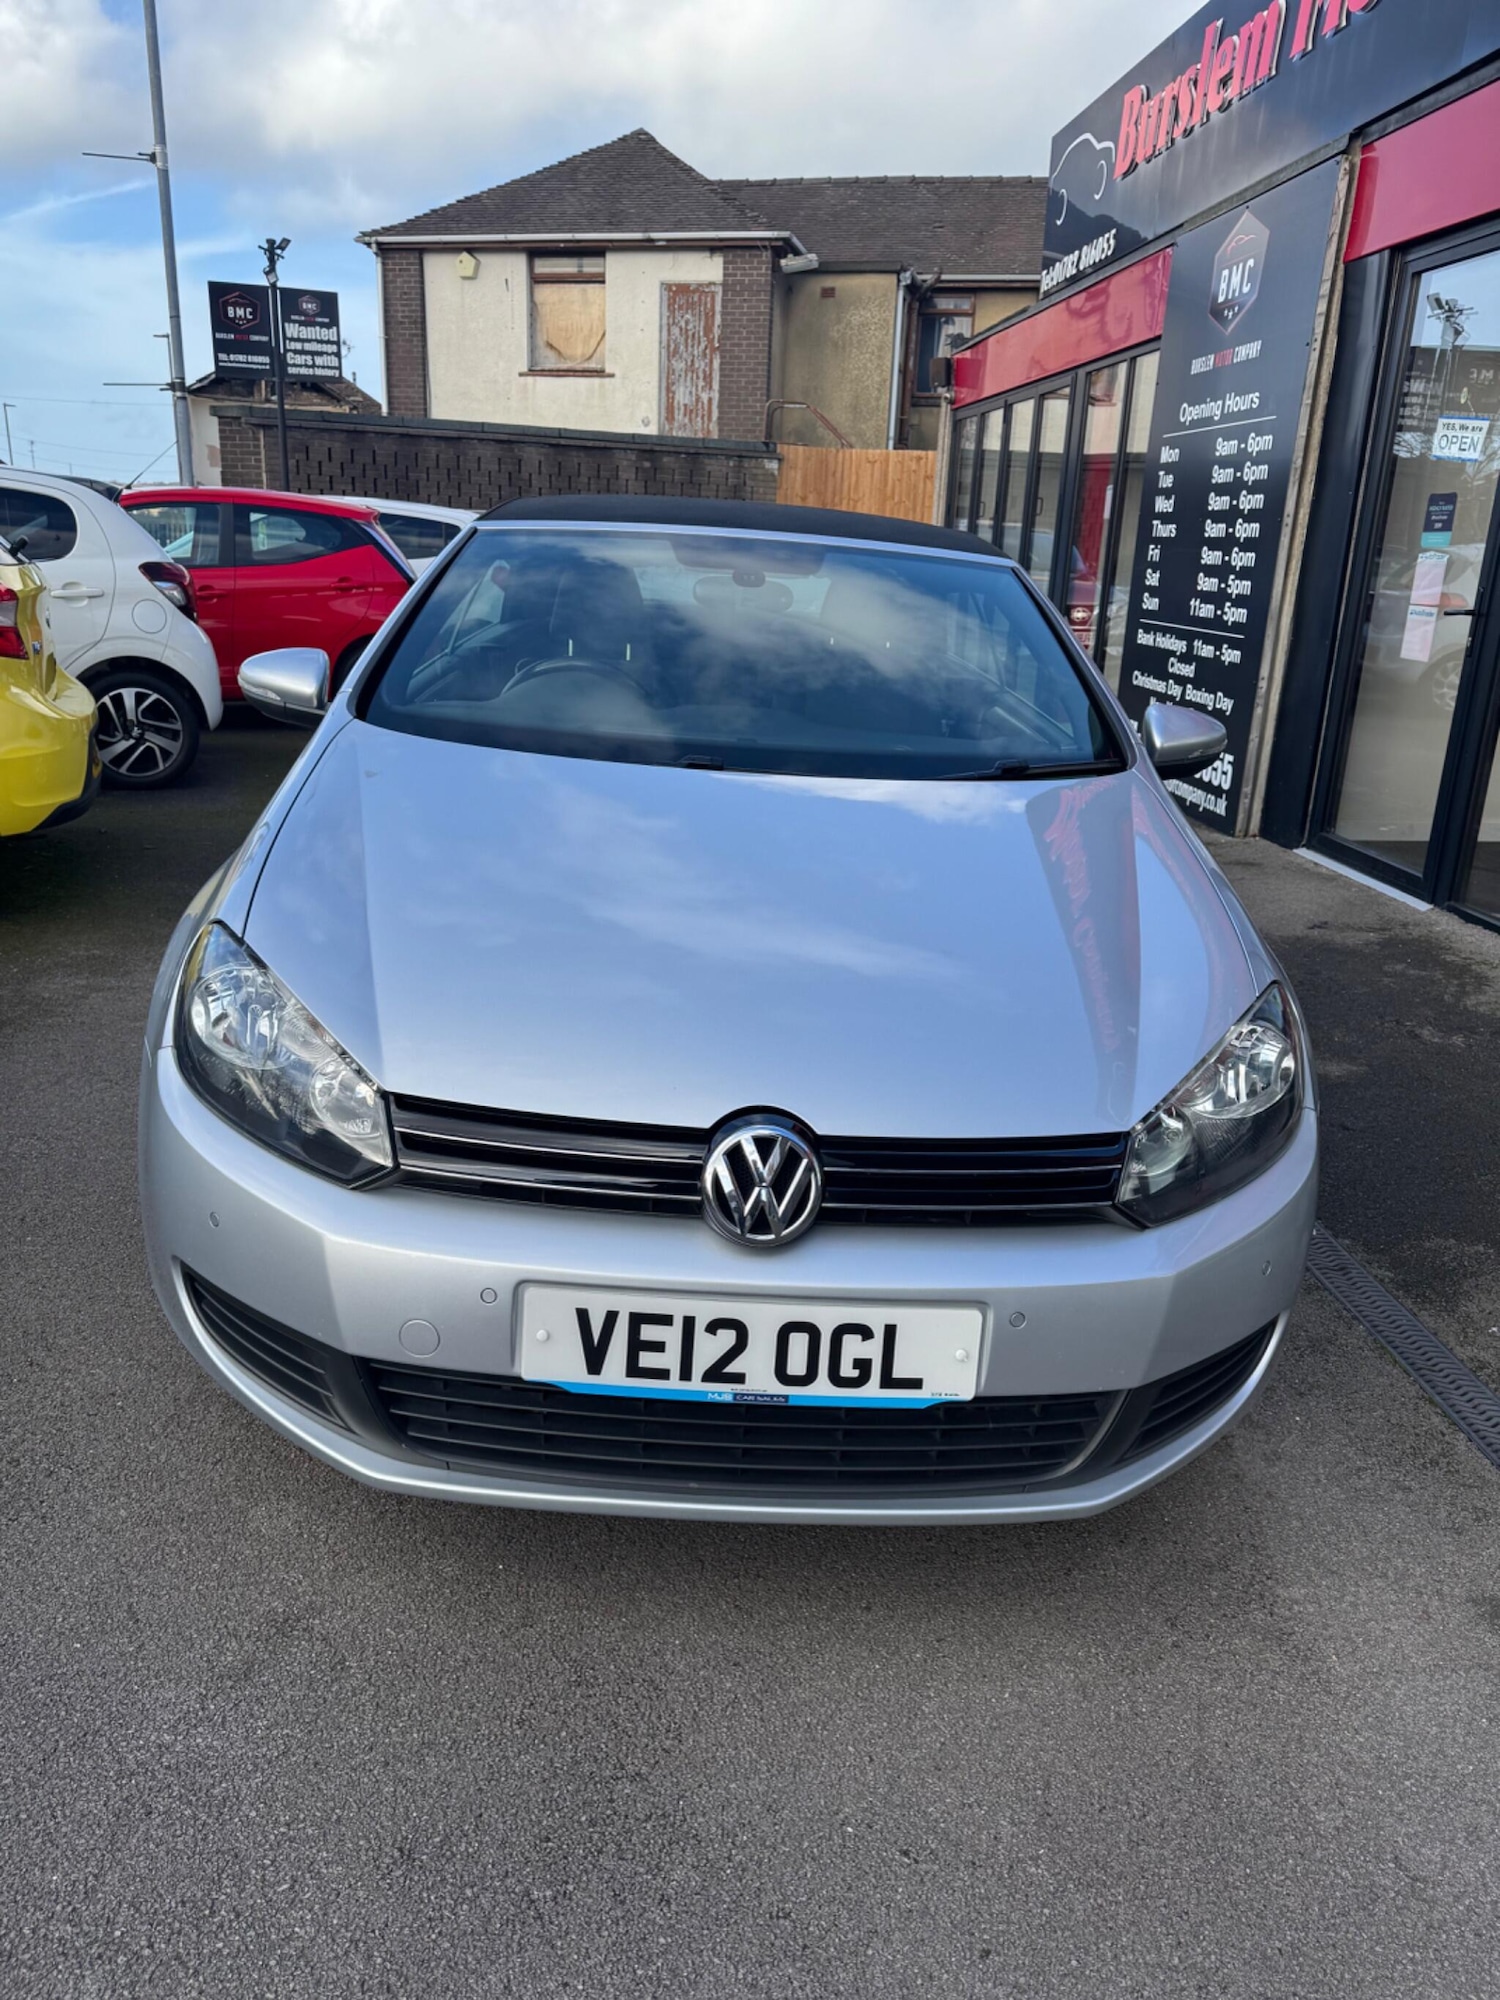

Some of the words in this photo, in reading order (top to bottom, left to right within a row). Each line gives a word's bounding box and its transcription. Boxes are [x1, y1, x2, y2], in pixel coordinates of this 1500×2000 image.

[1113, 0, 1286, 181] Burslem
[1078, 227, 1117, 271] 816055
[1218, 257, 1254, 304] BMC
[227, 306, 253, 319] BMC
[283, 322, 338, 342] Wanted
[286, 340, 302, 350] Low
[304, 341, 338, 354] mileage
[286, 351, 313, 366] Cars
[314, 353, 339, 367] with
[1233, 339, 1262, 364] COMPANY
[287, 365, 314, 376] service
[314, 366, 339, 378] history
[1179, 398, 1223, 426] Opening
[1224, 391, 1260, 415] Hours
[1458, 423, 1471, 431] We
[1470, 424, 1484, 432] are
[1160, 445, 1180, 464] Mon
[1214, 437, 1239, 456] 9am
[1246, 432, 1273, 458] 6pm
[1438, 434, 1480, 453] OPEN
[1157, 471, 1174, 489] Tue
[1210, 465, 1235, 484] 9am
[1242, 461, 1268, 487] 6pm
[1154, 495, 1175, 514] Wed
[1207, 491, 1230, 511] 9am
[1238, 490, 1265, 515] 6pm
[1151, 520, 1177, 539] Thurs
[1203, 521, 1227, 538] 9am
[1234, 518, 1260, 543] 6pm
[1147, 544, 1160, 563] Fri
[1199, 545, 1223, 566] 9am
[1230, 546, 1256, 571] 6pm
[1145, 568, 1160, 587] Sat
[1196, 572, 1219, 593] 9am
[1226, 573, 1251, 597] 5pm
[1141, 592, 1160, 612] Sun
[1189, 598, 1214, 619] 11am
[1222, 601, 1248, 626] 5pm
[1136, 628, 1155, 647] Bank
[1155, 631, 1187, 654] Holidays
[1193, 641, 1215, 659] 11am
[1221, 645, 1242, 666] 5pm
[1168, 657, 1196, 678] Closed
[1132, 670, 1167, 695] Christmas
[1167, 679, 1183, 701] Day
[1185, 684, 1215, 712] Boxing
[1216, 693, 1235, 716] Day
[575, 1307, 749, 1385] VE12
[774, 1320, 924, 1391] OGL
